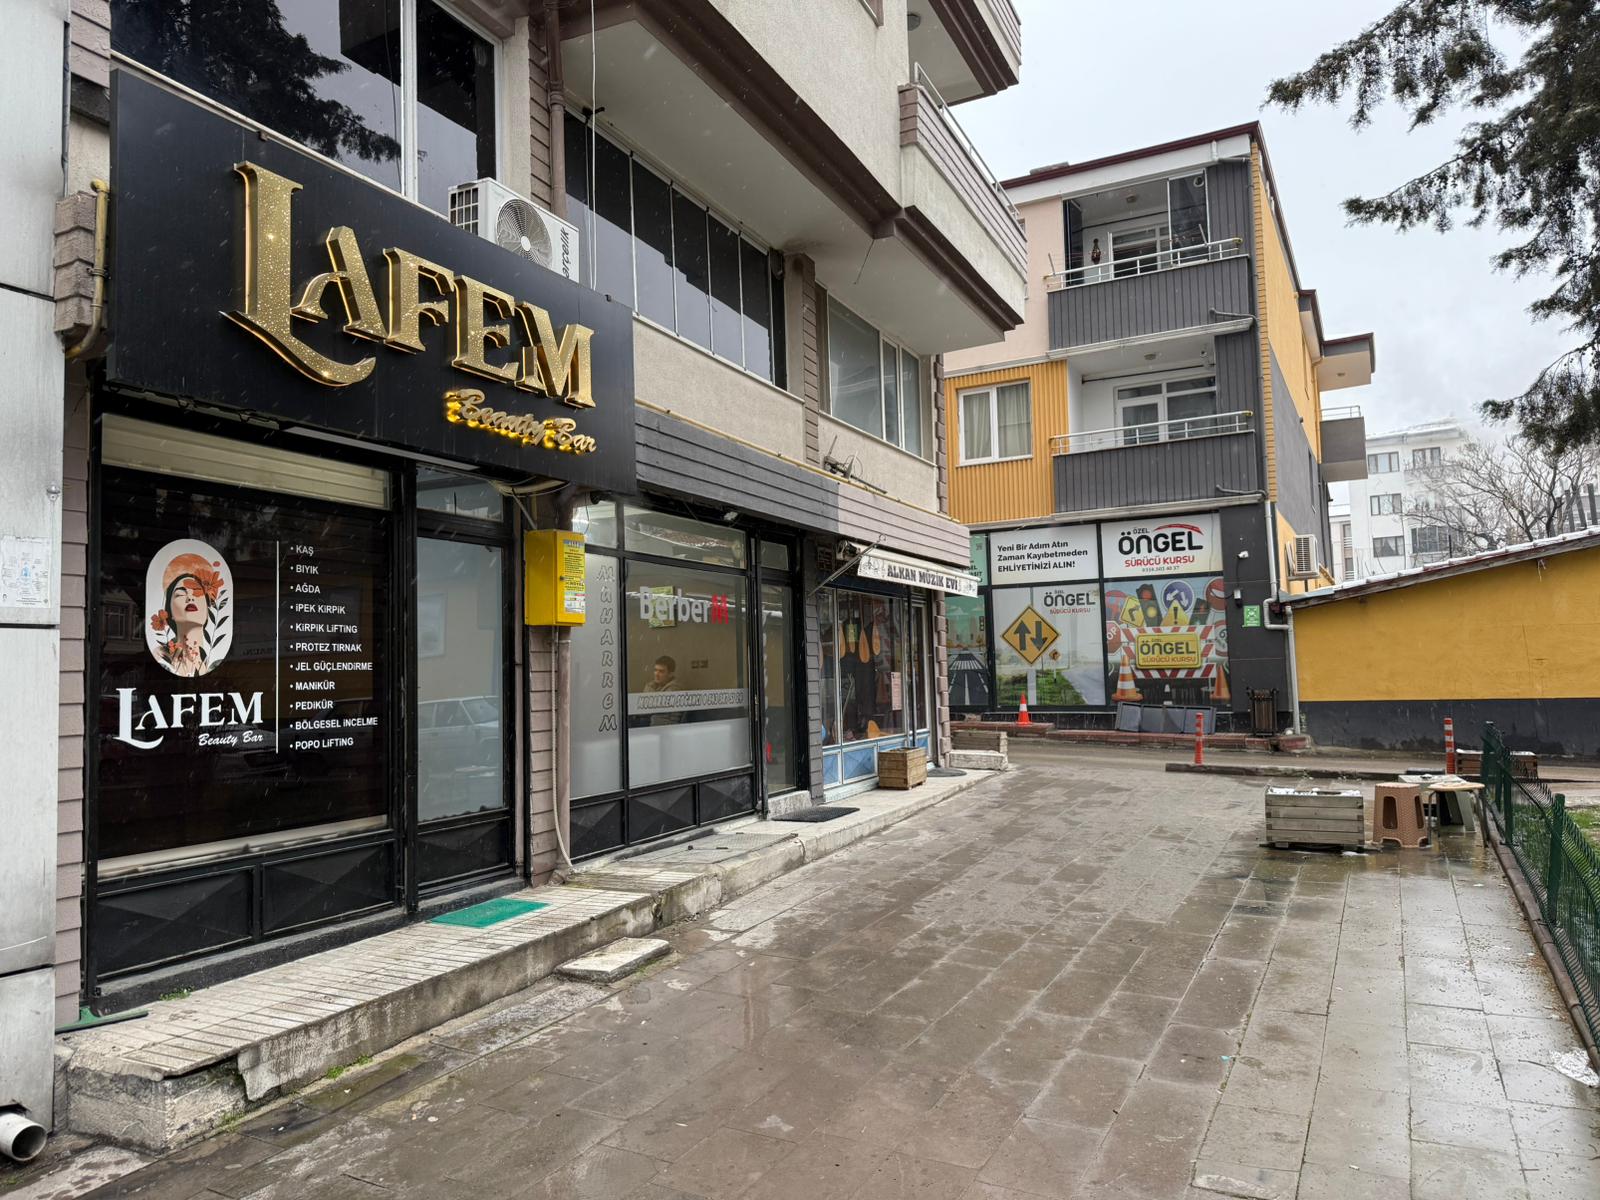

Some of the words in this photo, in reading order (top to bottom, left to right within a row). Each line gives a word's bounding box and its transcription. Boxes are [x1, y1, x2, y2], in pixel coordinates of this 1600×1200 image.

[560, 226, 571, 279] arçelik
[218, 160, 597, 409] LAFEM
[544, 417, 597, 453] Bar
[296, 545, 314, 556] KAŞ
[997, 543, 1015, 552] Yeni
[1016, 543, 1028, 551] Bir
[1029, 542, 1050, 550] Adım
[997, 554, 1026, 562] Zaman
[1026, 549, 1088, 561] Kayıbetmeden
[1124, 556, 1161, 568] SÜRÜCÜ
[1162, 555, 1195, 565] KURSU
[296, 564, 319, 575] BIYIK
[997, 561, 1051, 573] EHLİYETİNİZİ
[1052, 561, 1076, 569] ALIN!
[887, 565, 917, 583] ALKAN
[918, 570, 944, 587] MÜZİK
[295, 582, 321, 594] AĞDA
[295, 642, 330, 652] PROTEZ
[331, 643, 363, 653] TIRNAK
[295, 662, 312, 671] JEL
[113, 687, 264, 750] LAFEM
[295, 719, 342, 730] BÖLGESEL
[198, 732, 239, 746] Beauty
[242, 730, 264, 743] Bar
[295, 740, 321, 750] POPO
